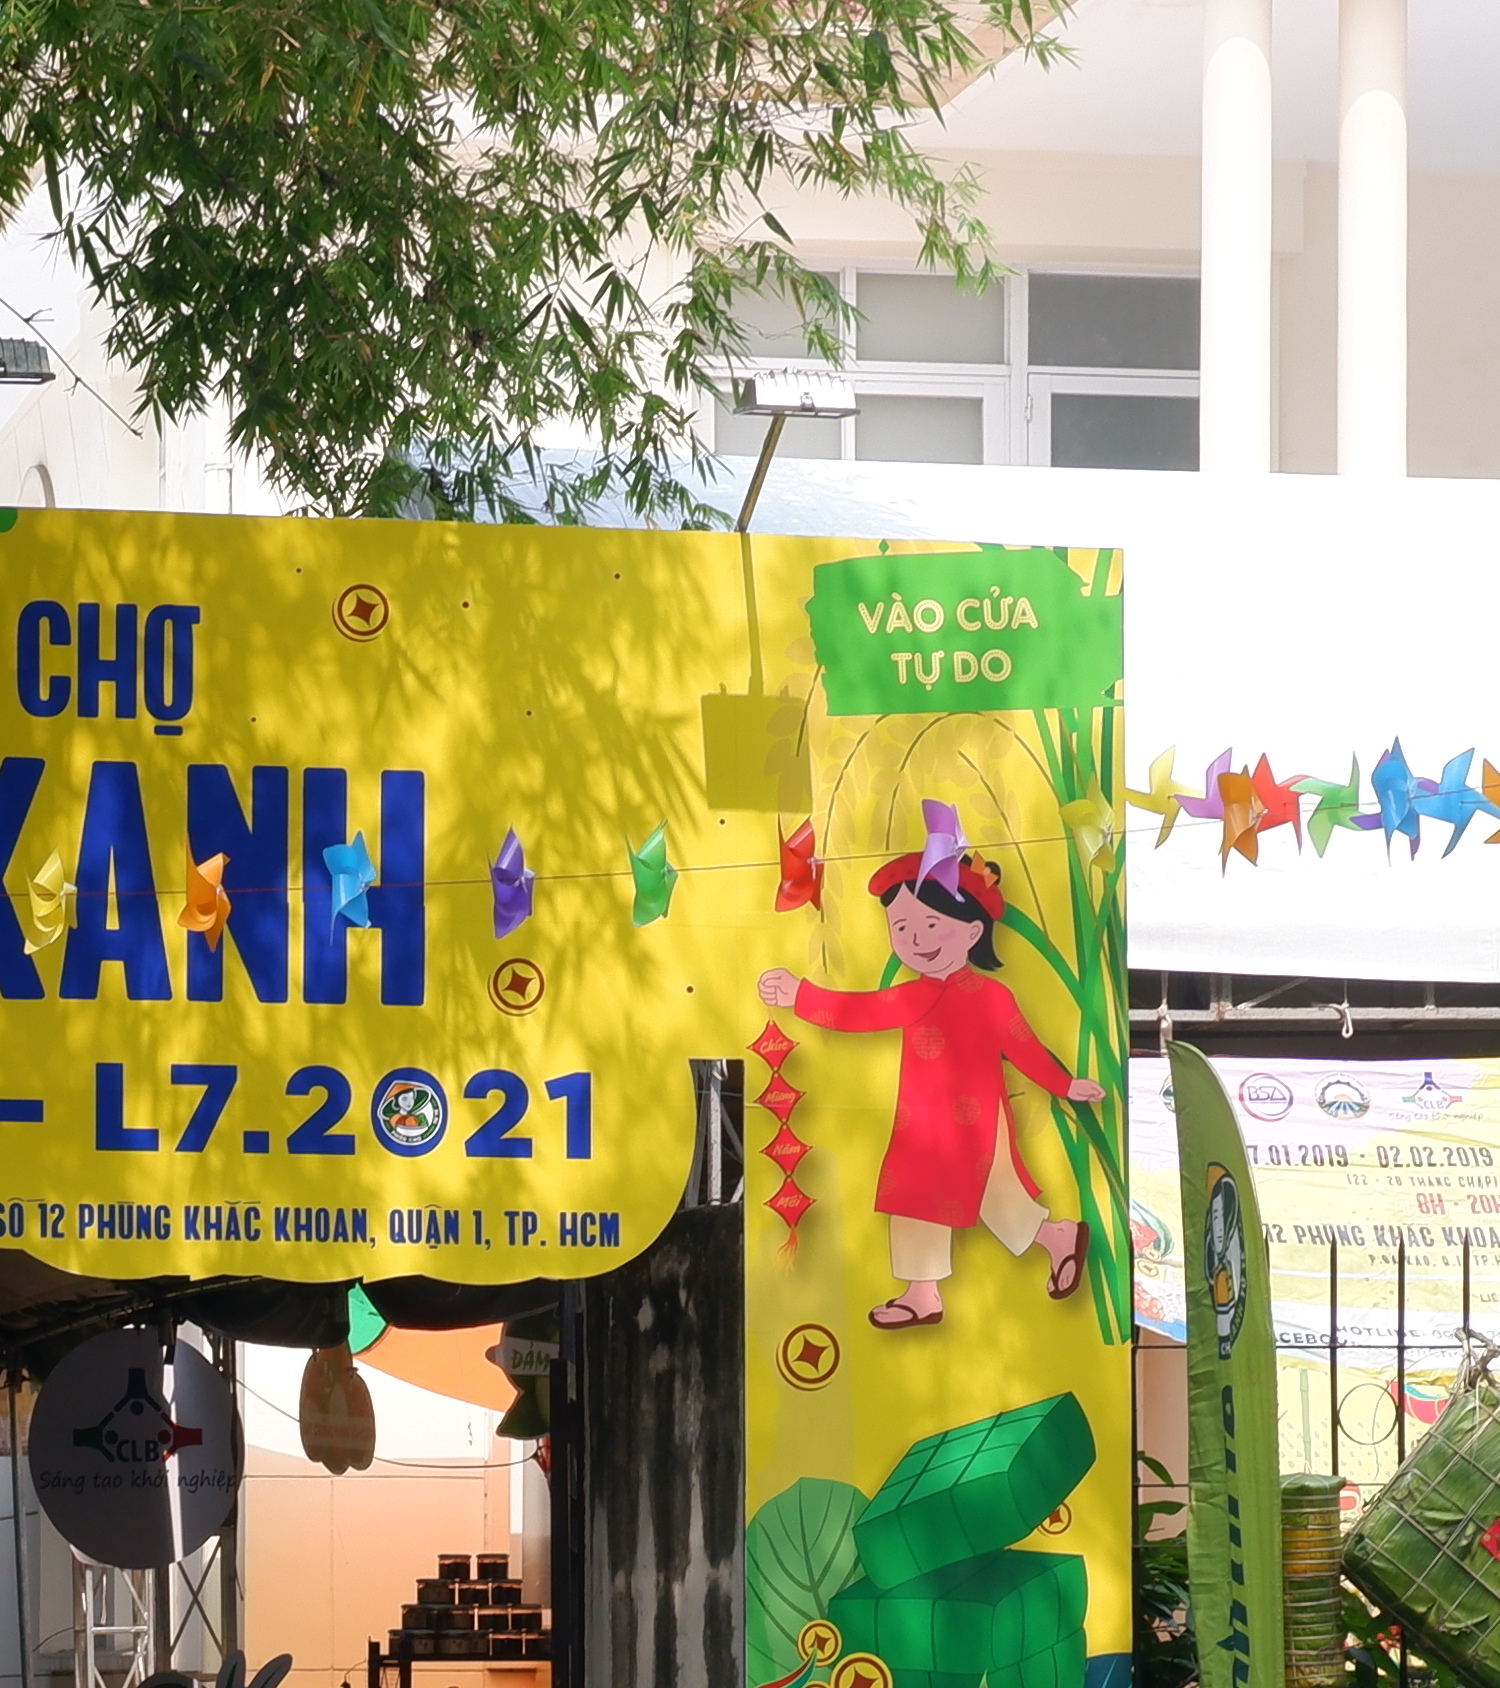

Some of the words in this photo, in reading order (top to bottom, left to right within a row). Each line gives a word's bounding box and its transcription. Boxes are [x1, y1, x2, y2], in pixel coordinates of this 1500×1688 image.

[858, 592, 944, 634] VÀO
[957, 586, 1038, 631] CỬA
[17, 599, 201, 735] CHỢ
[891, 650, 944, 691] TỰ
[953, 649, 1012, 683] DO
[96, 1062, 591, 1160] L7.2021
[1248, 1144, 1349, 1168] 7.01.2019
[1377, 1145, 1494, 1168] 02.02.2019
[37, 1204, 66, 1239] 12
[274, 1206, 377, 1250] KHOAN,
[389, 1203, 459, 1250] QUẬN
[472, 1210, 491, 1251] 1,
[505, 1211, 547, 1248] TP.
[560, 1211, 621, 1249] HCM
[116, 1439, 159, 1462] CLB
[39, 1471, 85, 1494] Sáng
[93, 1472, 122, 1489] tạo
[131, 1469, 170, 1490] khởi
[177, 1470, 239, 1494] nghiệp
